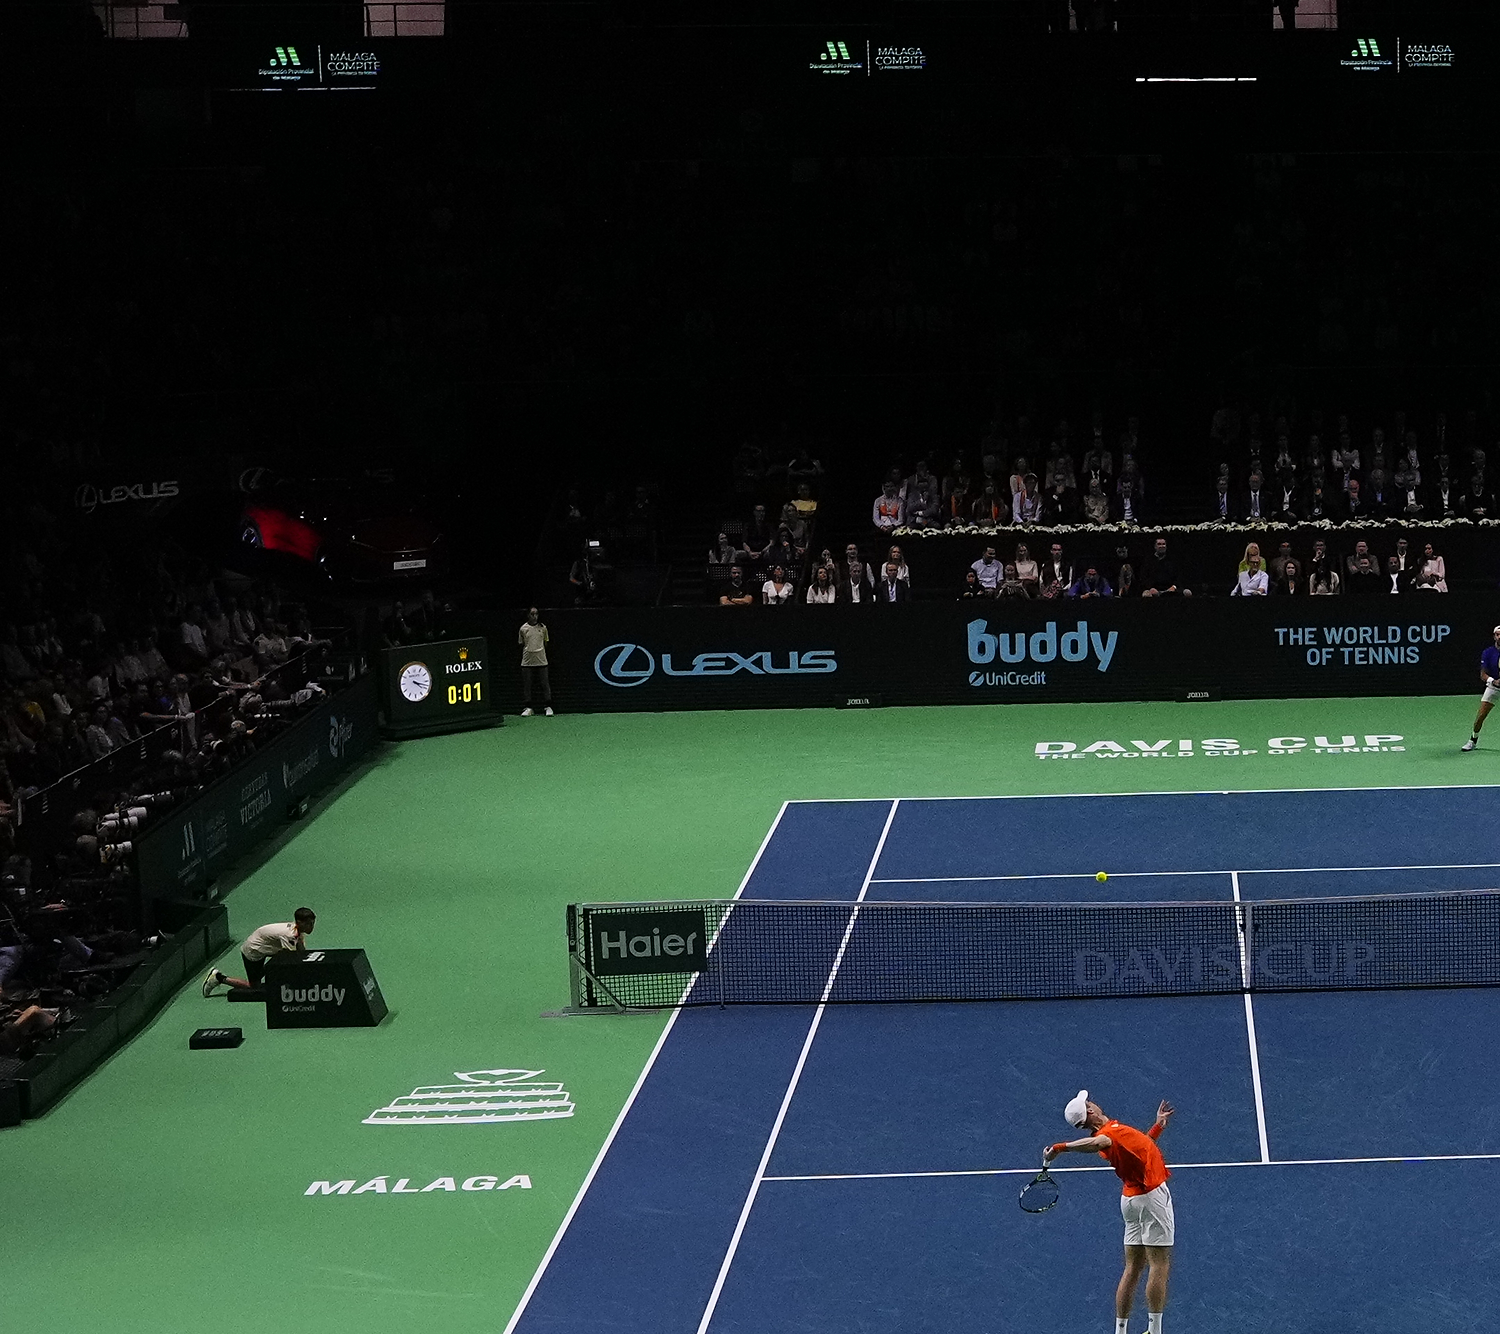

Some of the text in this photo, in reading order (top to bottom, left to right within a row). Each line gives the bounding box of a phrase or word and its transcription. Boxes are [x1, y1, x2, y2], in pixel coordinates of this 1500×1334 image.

[330, 51, 377, 61] MÁLAGA
[878, 46, 922, 55] MÁLAGA
[1405, 54, 1455, 62] COMPITE
[1408, 43, 1451, 53] MÁLAGA
[327, 61, 380, 71] COMPITE
[875, 56, 926, 65] COMPITE
[99, 481, 179, 504] LEXUS
[966, 619, 1119, 672] buddy
[1275, 624, 1451, 646] THE WORLD CUP
[662, 650, 837, 676] LEXUS
[1306, 645, 1420, 666] OF TENNIS
[446, 661, 482, 674] ROLEX
[985, 670, 1047, 687] UniCredit
[448, 682, 481, 705] 0:01
[1035, 734, 1404, 755] DAVIS CUP
[1095, 750, 1195, 759] WORLD
[1205, 749, 1258, 757] CUP
[1302, 745, 1408, 754] TENNIS
[601, 929, 697, 960] Haier
[1076, 941, 1375, 985] DAVIS CUP
[280, 984, 346, 1006] buddy
[304, 1174, 532, 1196] MÁLAGA
